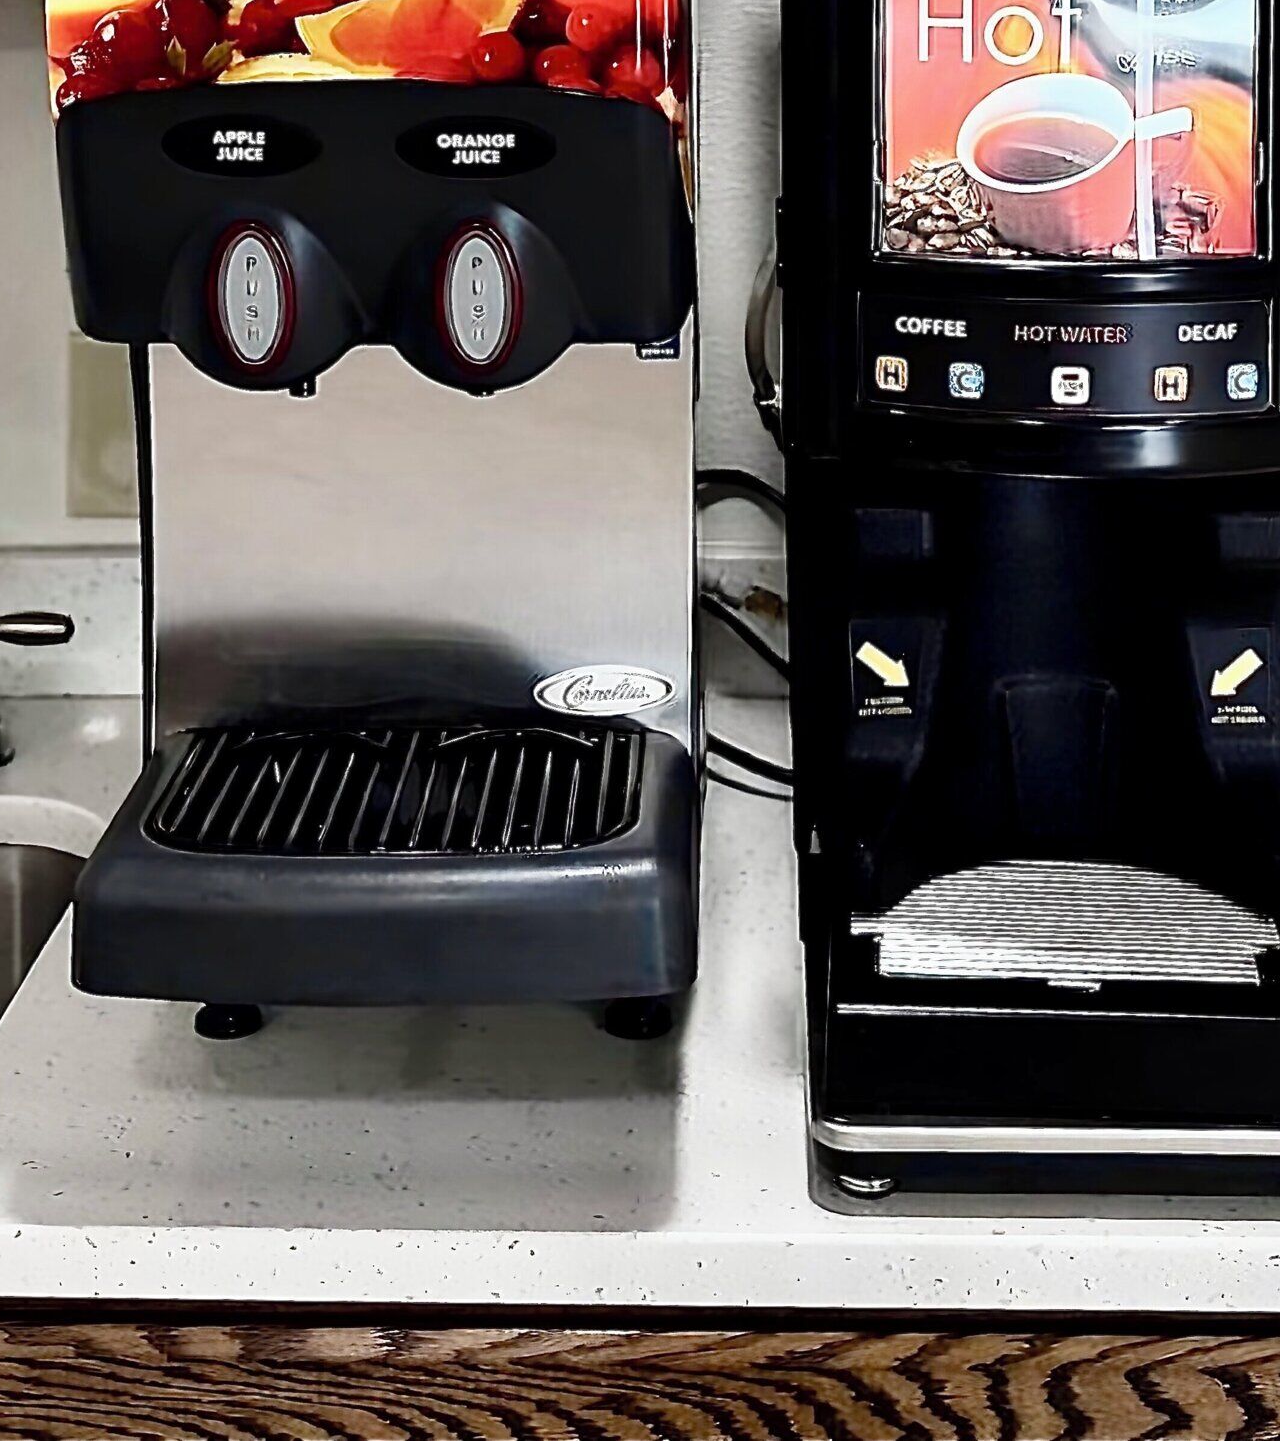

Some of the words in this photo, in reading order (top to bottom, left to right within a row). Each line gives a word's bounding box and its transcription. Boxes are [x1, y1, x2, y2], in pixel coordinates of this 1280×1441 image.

[212, 130, 266, 146] APPLE
[436, 133, 516, 149] ORANGE
[215, 146, 264, 161] JUICE
[451, 149, 501, 165] JUICE
[894, 315, 968, 338] COFFEE
[1013, 324, 1056, 342] HOT
[1060, 325, 1128, 344] WATER
[1177, 322, 1238, 343] DECAF
